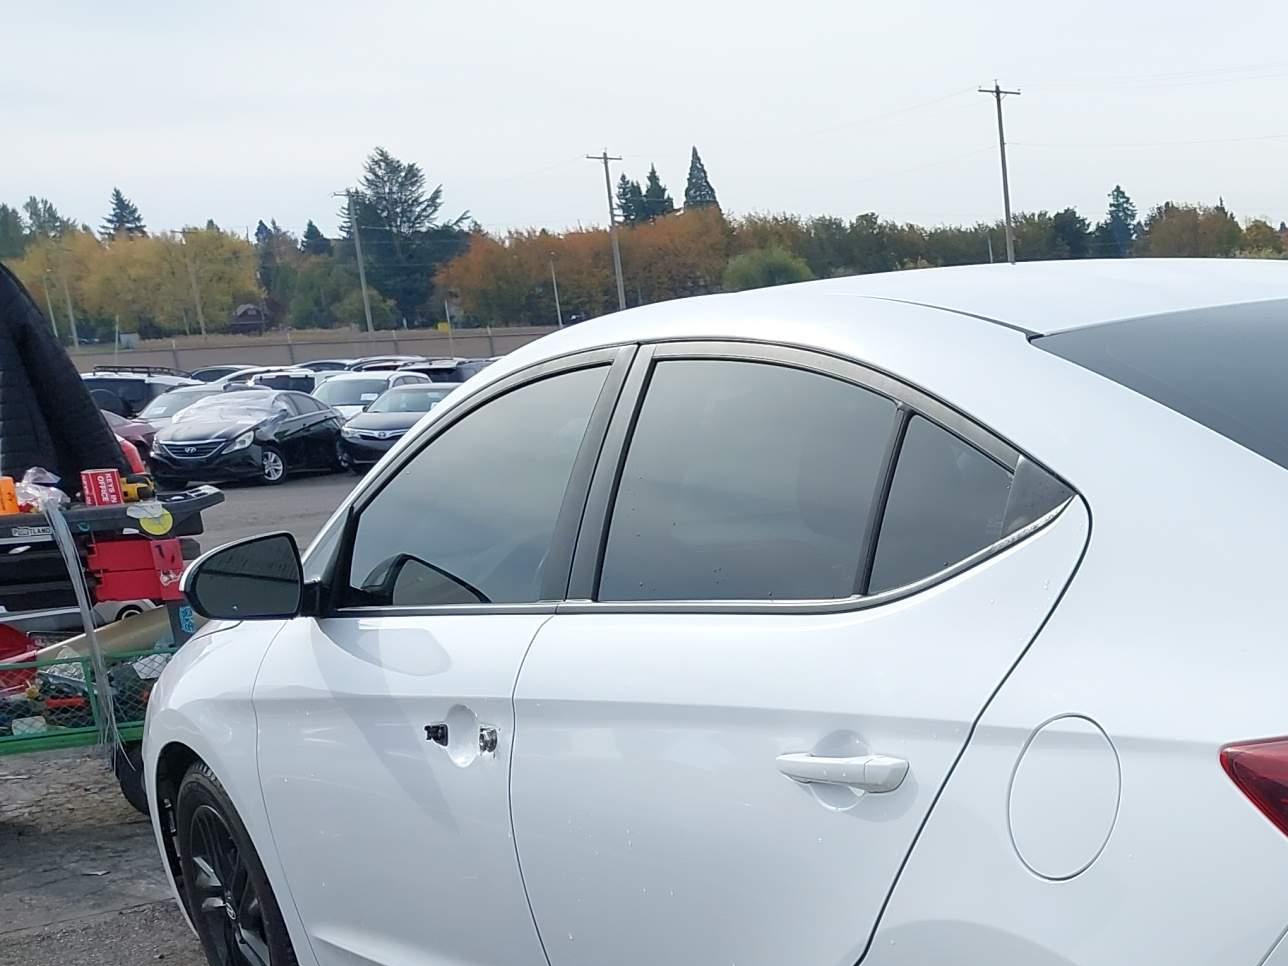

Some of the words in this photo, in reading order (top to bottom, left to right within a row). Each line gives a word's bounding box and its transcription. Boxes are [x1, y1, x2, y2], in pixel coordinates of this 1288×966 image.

[97, 475, 110, 502] OFFICE
[105, 473, 115, 493] KEYS
[111, 494, 118, 503] IN
